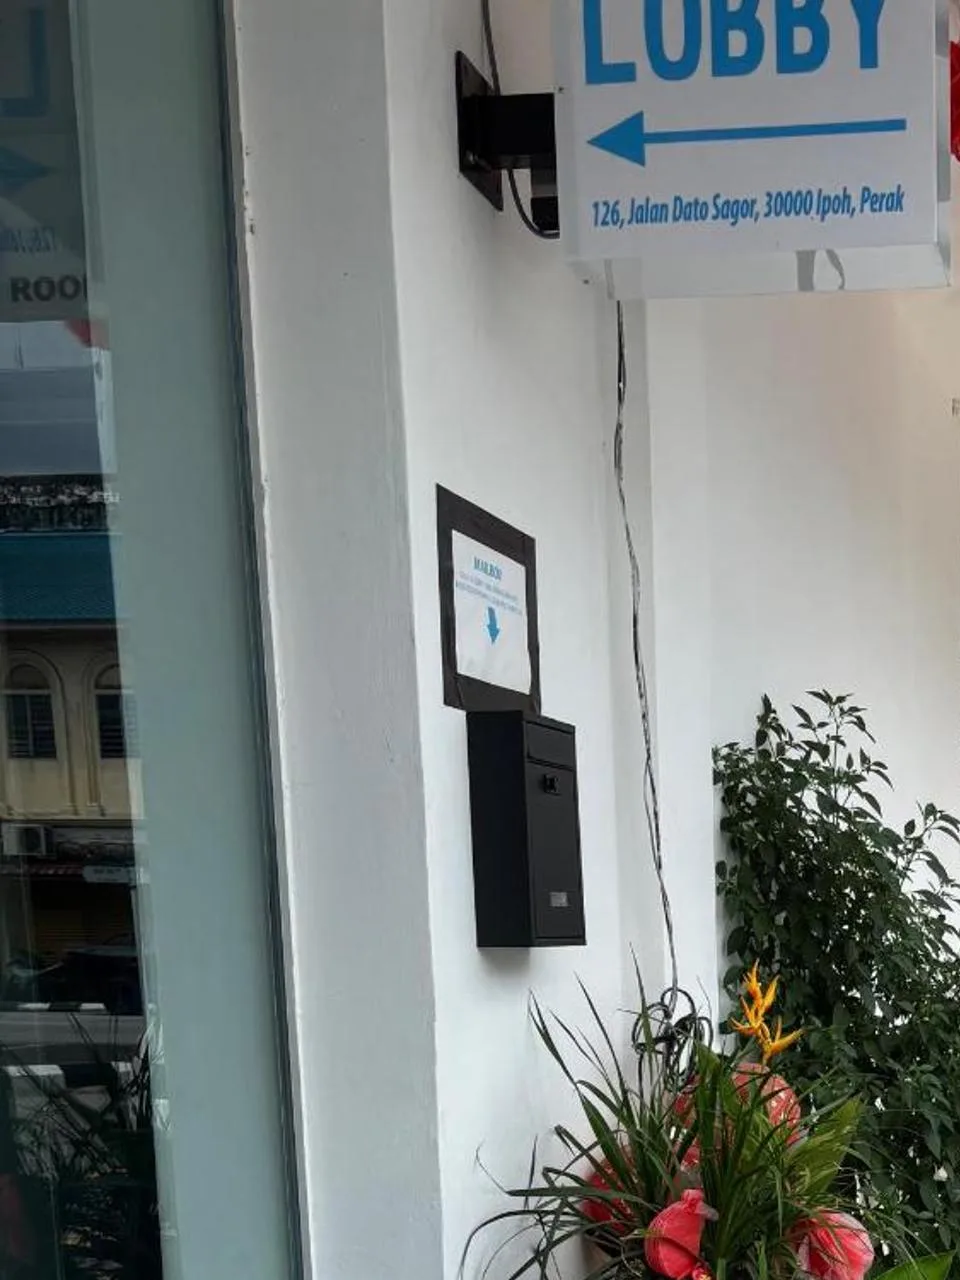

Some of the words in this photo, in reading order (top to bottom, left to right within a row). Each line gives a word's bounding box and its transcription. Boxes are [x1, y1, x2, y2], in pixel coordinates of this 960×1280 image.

[583, 0, 885, 85] LOBBY
[592, 200, 625, 229] 126,
[627, 196, 669, 225] Jalan
[672, 195, 709, 222] Dato
[711, 193, 760, 226] Sagor,
[764, 190, 814, 218] 30000
[815, 187, 856, 222] Ipoh,
[859, 184, 905, 214] Perak
[10, 274, 88, 302] ROO
